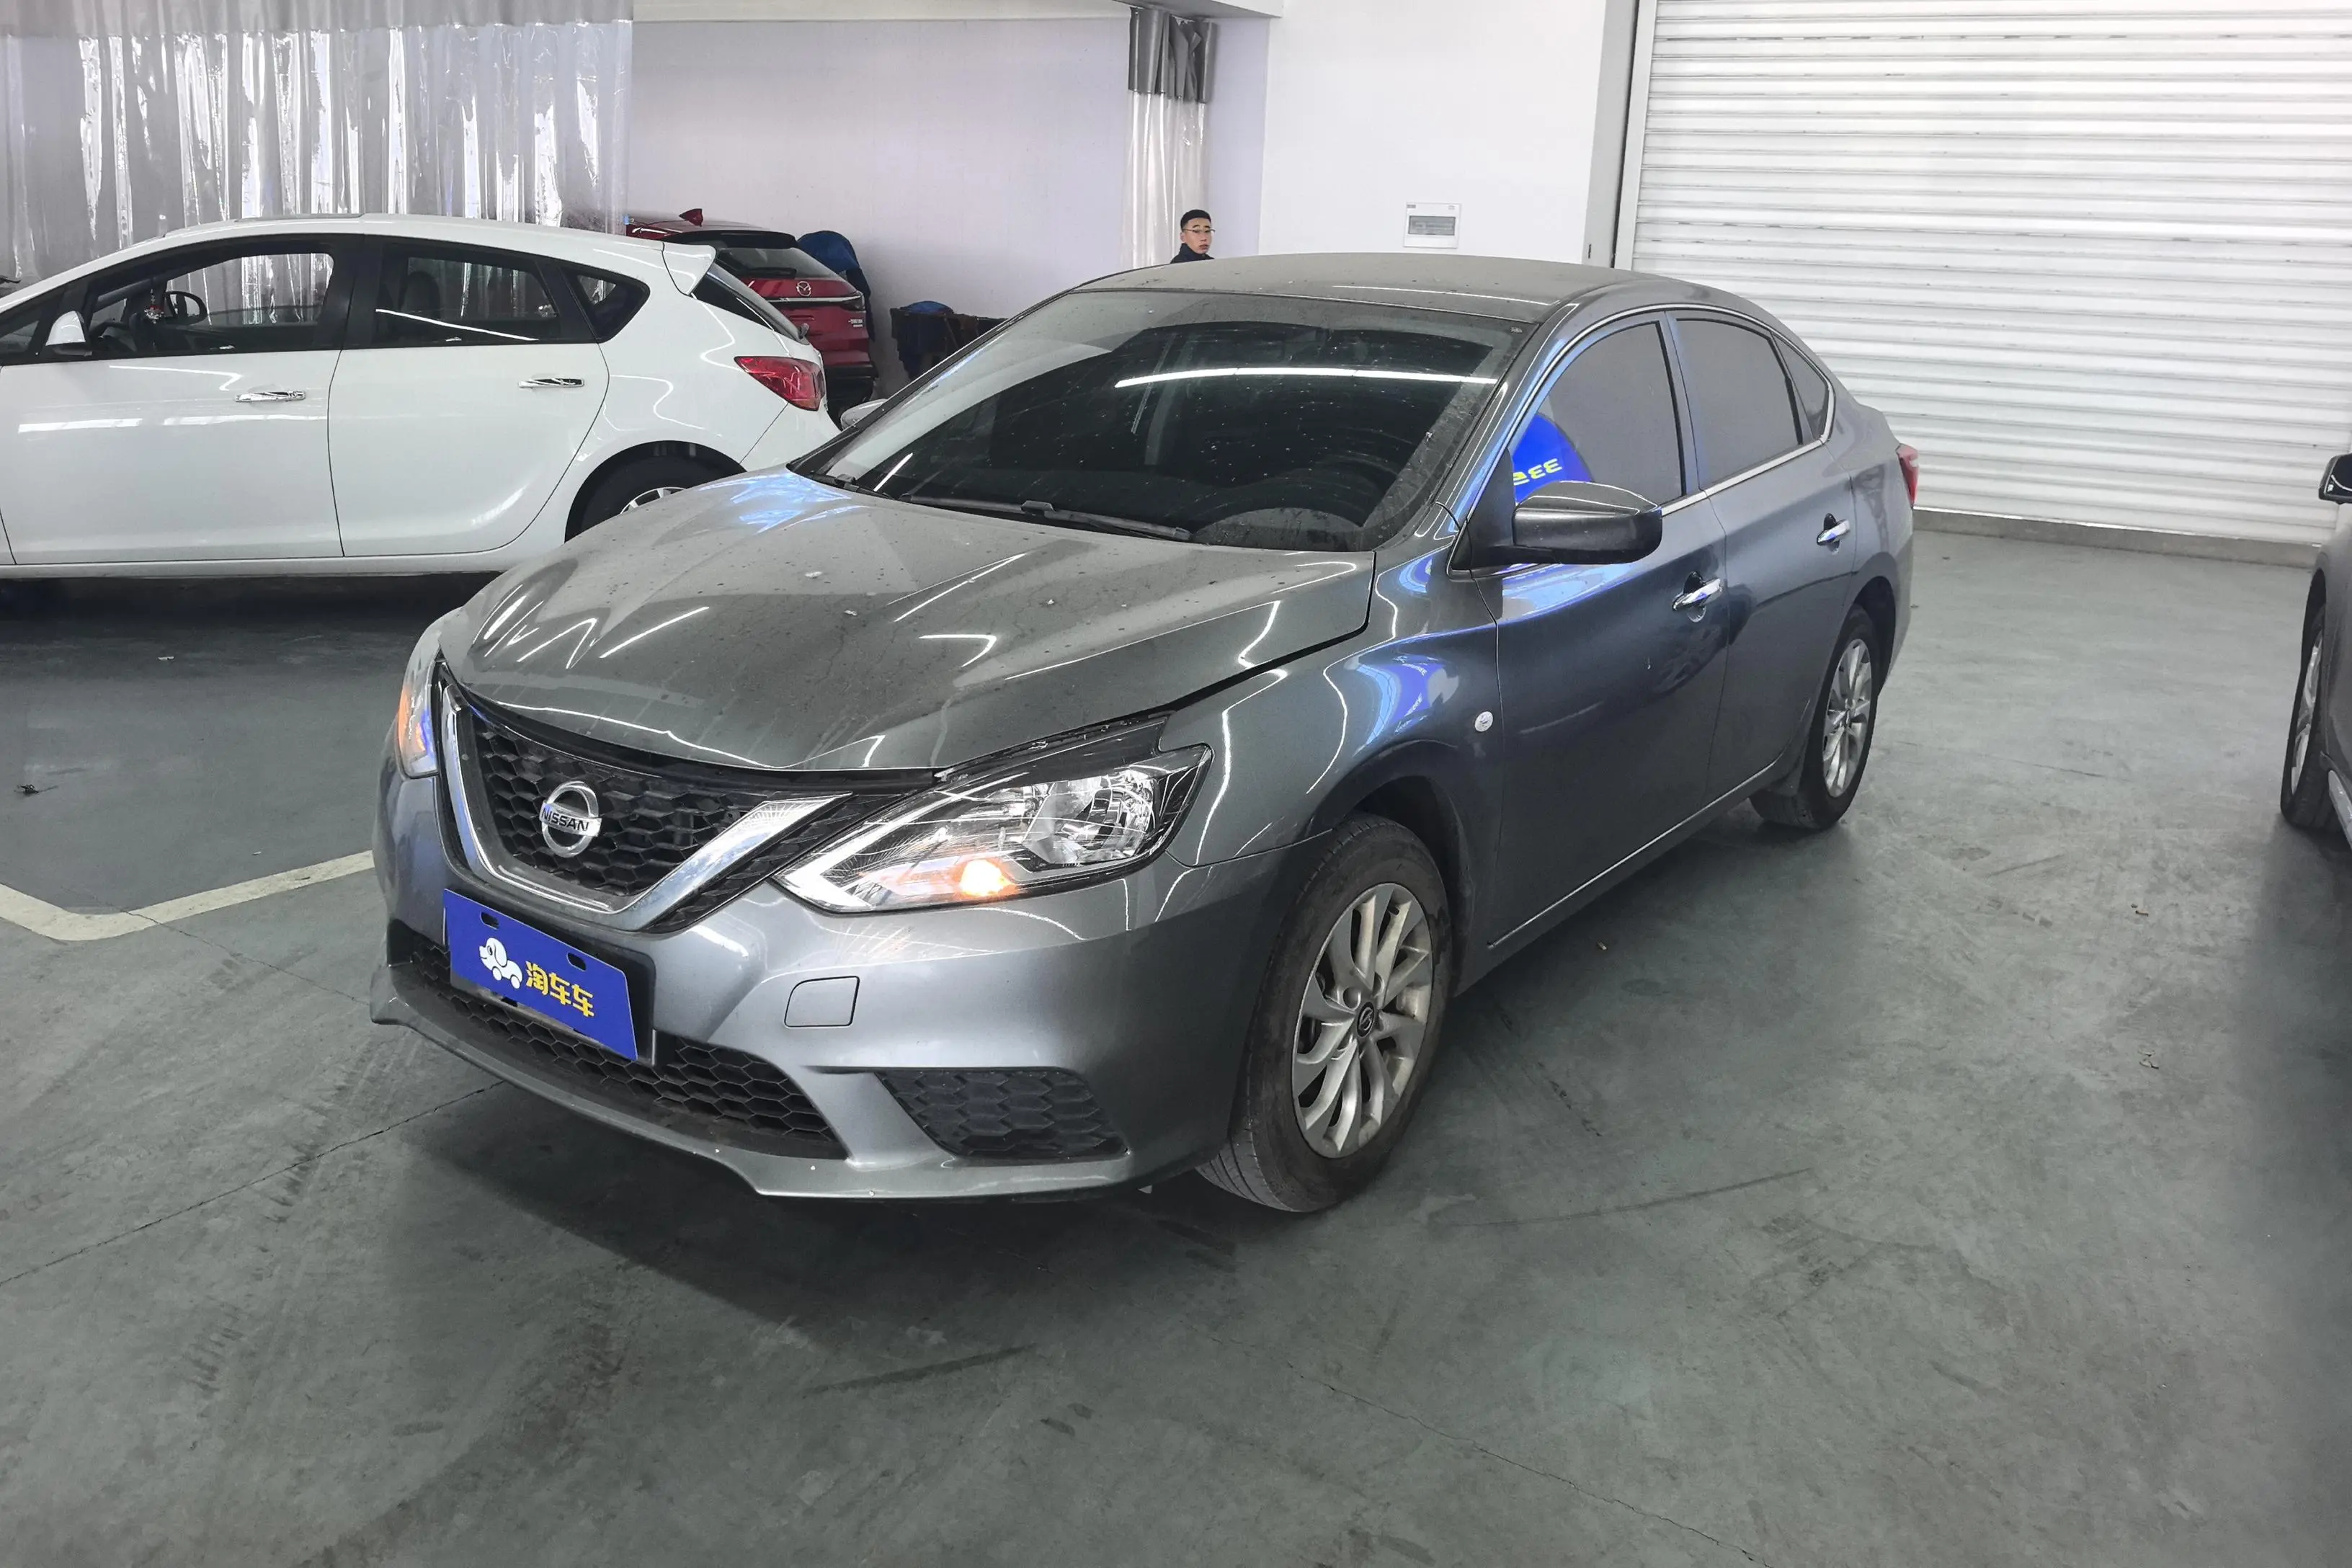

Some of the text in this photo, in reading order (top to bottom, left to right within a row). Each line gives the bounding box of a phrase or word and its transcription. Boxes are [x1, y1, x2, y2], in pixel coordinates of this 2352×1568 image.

[541, 808, 589, 832] NISSAN
[525, 961, 594, 1017] 淘车车
